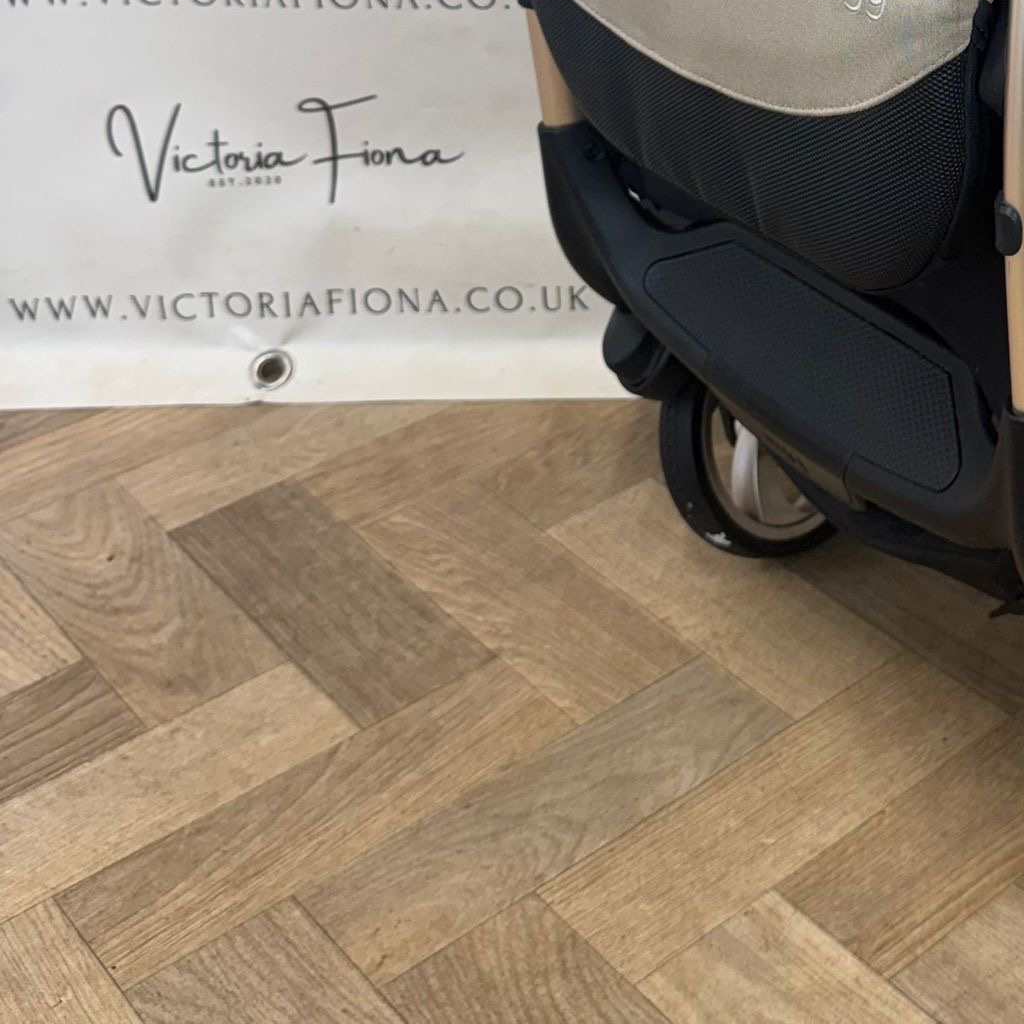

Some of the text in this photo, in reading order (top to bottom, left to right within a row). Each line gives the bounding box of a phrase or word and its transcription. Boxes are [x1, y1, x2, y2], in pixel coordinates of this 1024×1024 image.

[106, 94, 465, 204] Victoria Fiona
[7, 285, 592, 323] WWW.VICTORIAFIONA.CO.UK
